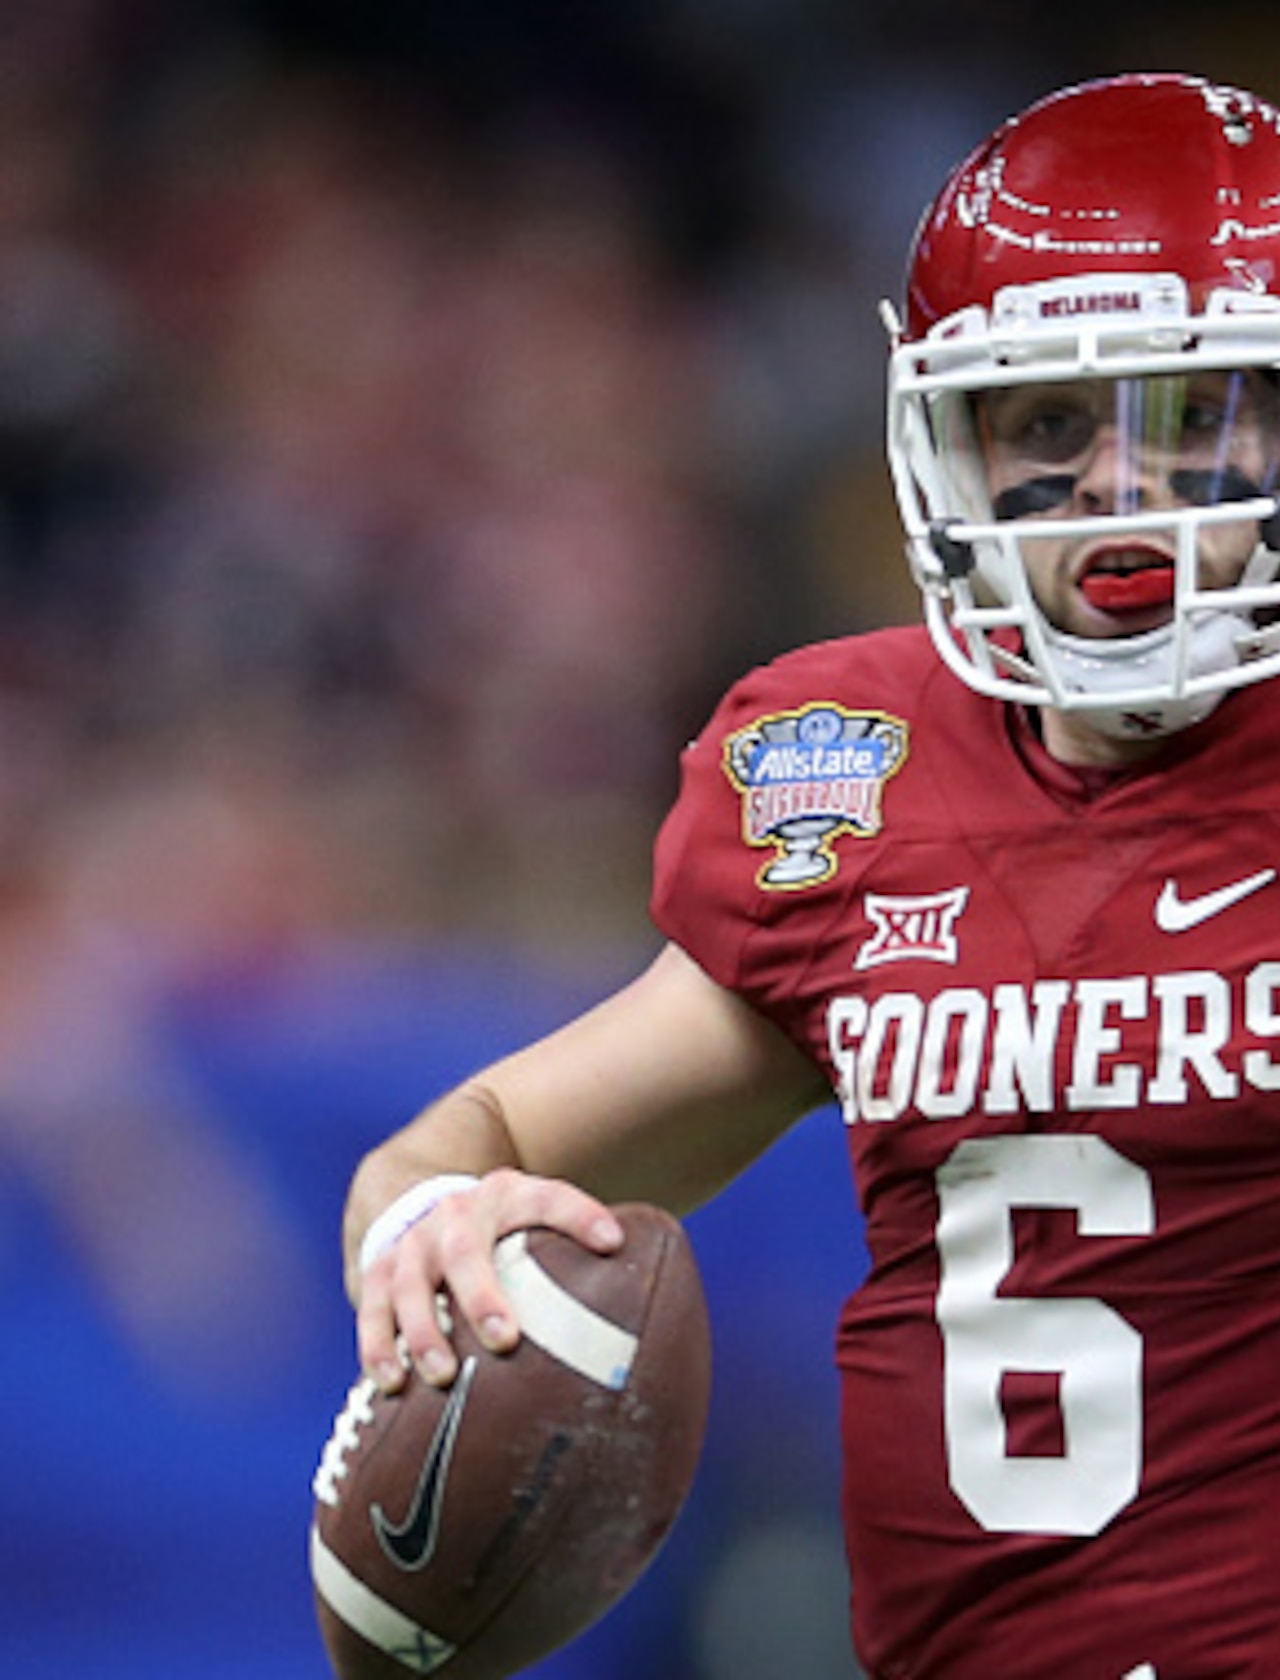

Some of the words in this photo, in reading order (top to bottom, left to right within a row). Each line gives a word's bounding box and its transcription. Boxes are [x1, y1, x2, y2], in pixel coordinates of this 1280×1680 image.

[754, 745, 877, 782] Allstate
[855, 886, 970, 970] XII
[935, 1133, 1157, 1538] 6
